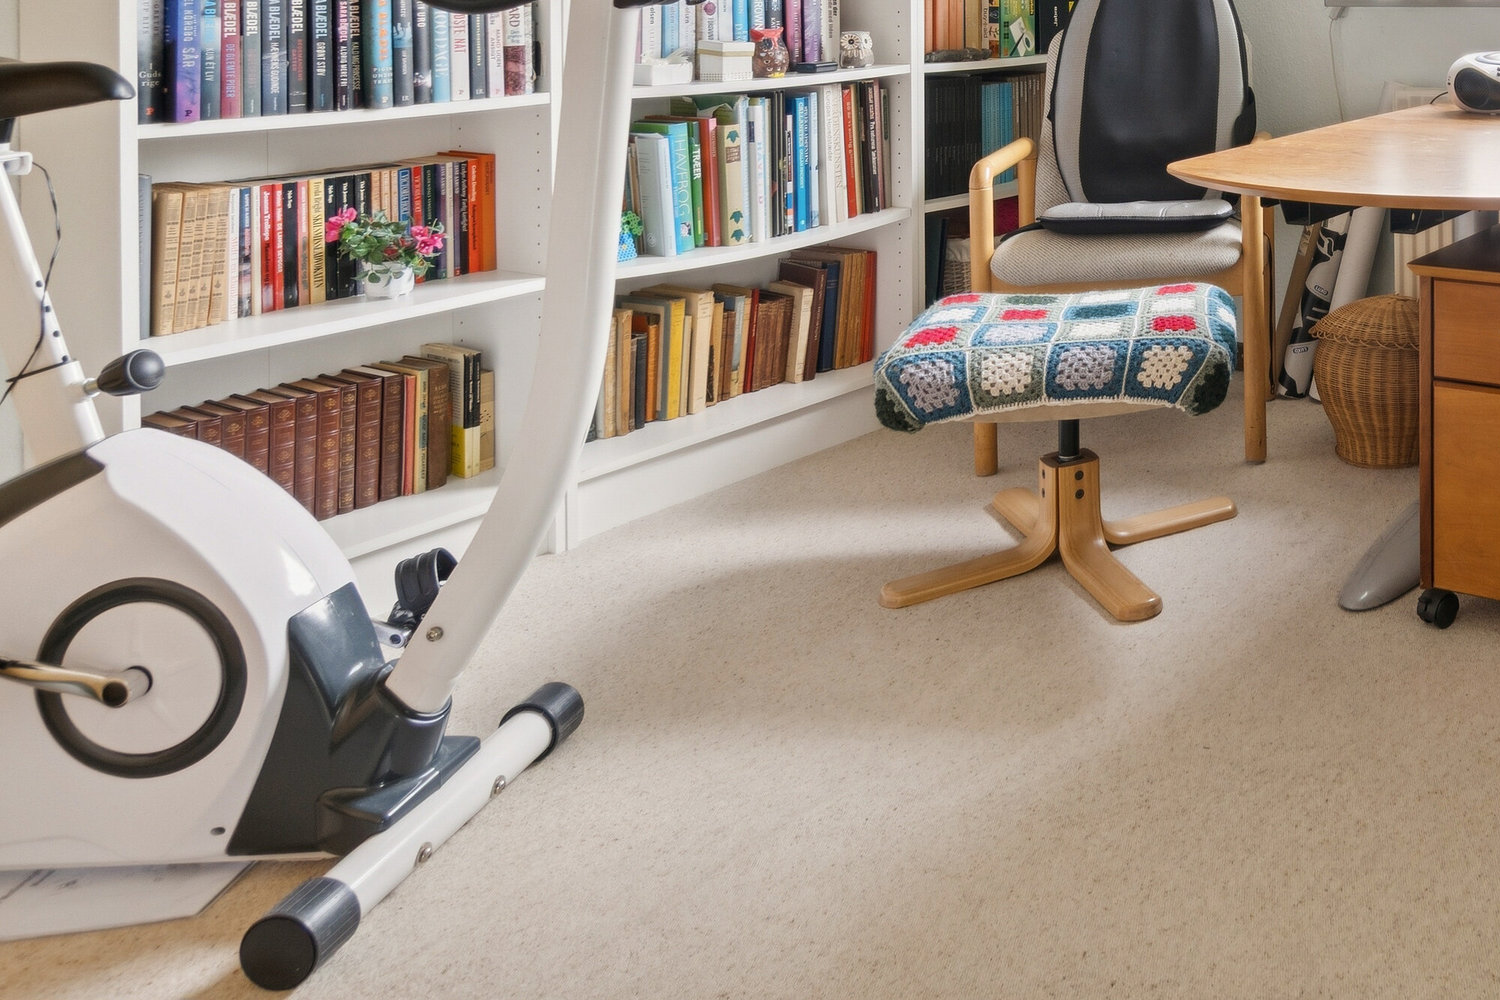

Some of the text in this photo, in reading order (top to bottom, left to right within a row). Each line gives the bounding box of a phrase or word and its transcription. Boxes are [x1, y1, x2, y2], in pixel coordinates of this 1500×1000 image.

[224, 2, 236, 38] BLÆDEL
[246, 0, 259, 36] BLÆDEL
[268, 5, 281, 40] BLÆDEL
[291, 0, 304, 34] BLÆDEL
[314, 4, 328, 39] BLÆDEL
[340, 1, 348, 17] SARA
[349, 5, 360, 39] BLÆDEL
[226, 43, 235, 51] DE
[378, 11, 388, 61] BLÆDEL
[454, 38, 466, 54] NAT
[182, 47, 199, 68] SÅR
[225, 53, 235, 77] GLEMTE
[226, 79, 235, 98] PIGER
[692, 148, 702, 180] TRÆER
